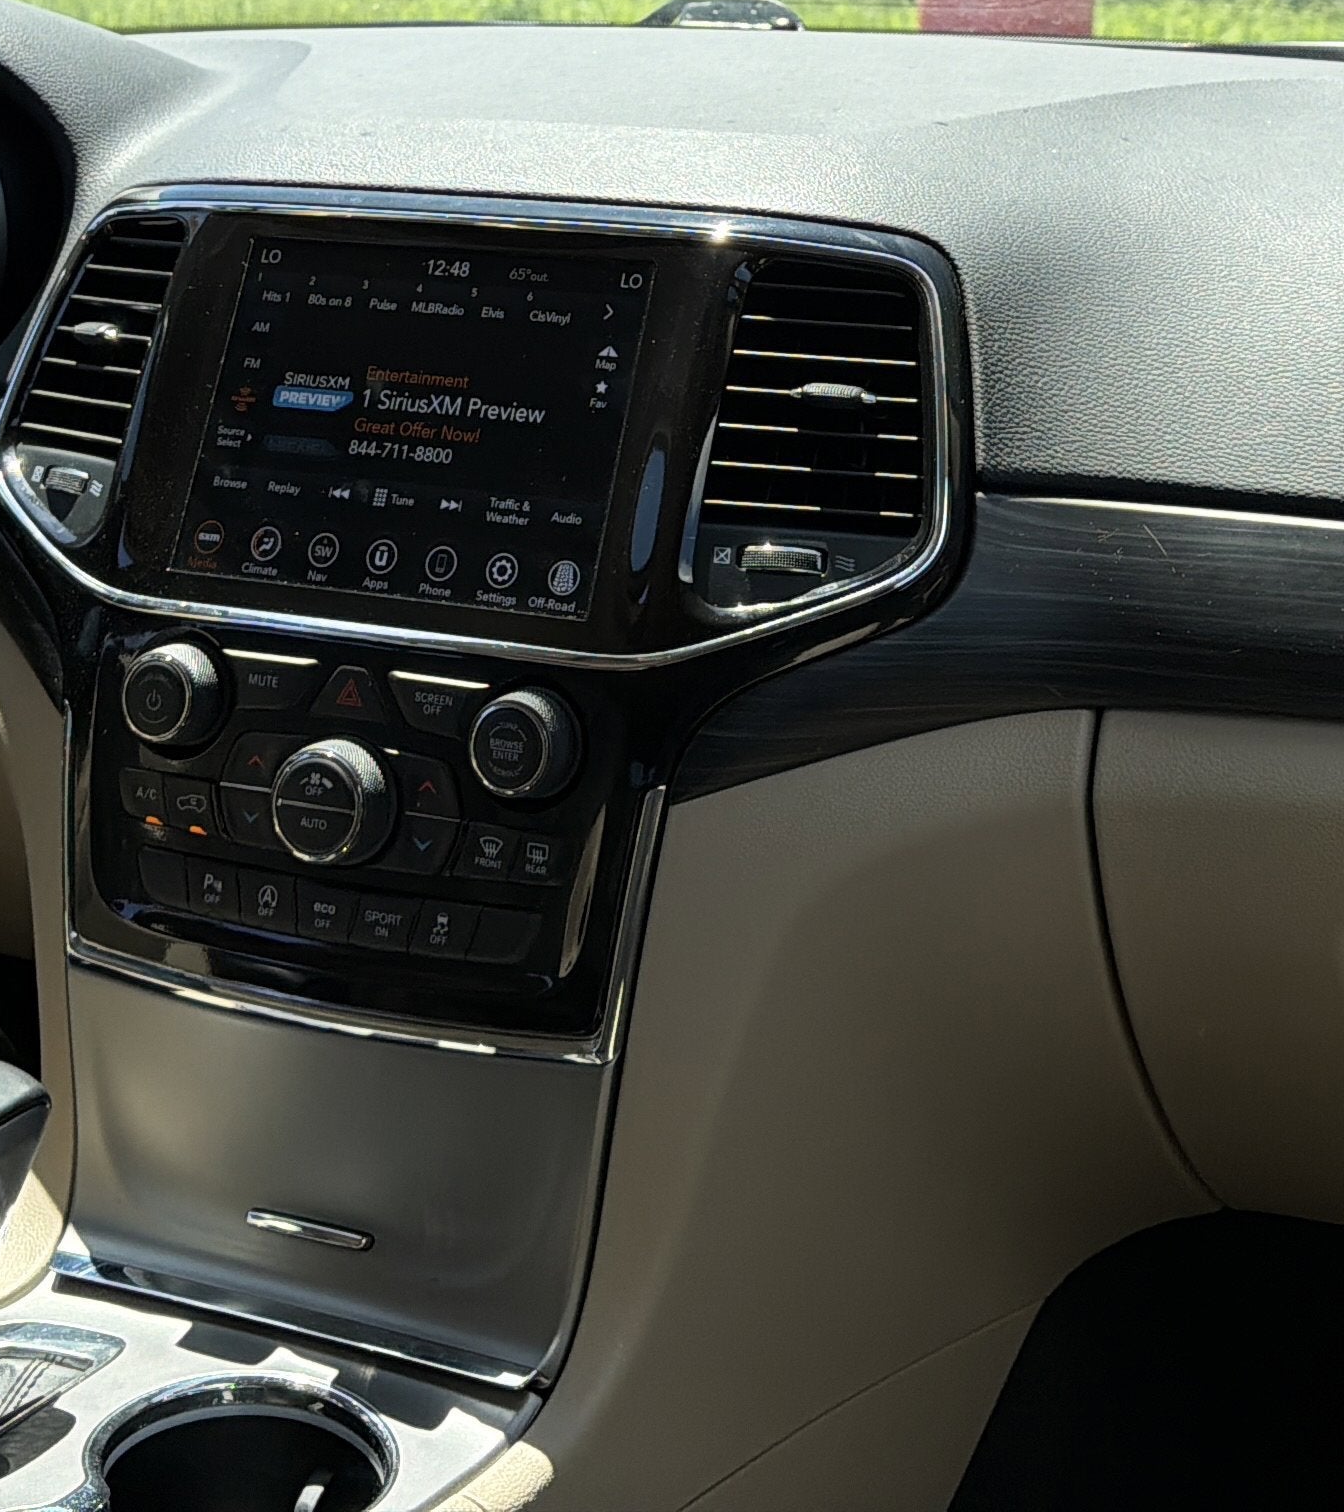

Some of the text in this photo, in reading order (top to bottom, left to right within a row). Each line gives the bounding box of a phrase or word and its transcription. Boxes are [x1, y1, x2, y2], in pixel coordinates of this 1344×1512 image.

[261, 249, 282, 264] LO
[426, 259, 471, 277] 12:48
[309, 276, 316, 286] 2
[362, 280, 368, 289] 3
[621, 273, 642, 289] LO
[416, 284, 422, 293] 4
[471, 288, 478, 297] 5
[262, 290, 290, 302] Hits 1
[308, 294, 352, 307] 80s on 8
[527, 292, 534, 301] 6
[369, 298, 397, 311] Pulse
[411, 301, 464, 316] MLBRadio
[481, 307, 505, 319] Elvis
[252, 322, 270, 333] AM
[244, 358, 260, 369] FM
[595, 359, 617, 371] Map
[283, 372, 350, 389] SIRIUSXM
[366, 366, 469, 388] Entertainment
[280, 390, 346, 408] PREVIEW
[589, 398, 608, 408] Fav
[362, 388, 545, 425] 1 SiriusXM Preview
[217, 426, 245, 437] Source
[354, 418, 481, 443] Great Offer Now!
[216, 437, 241, 448] Select
[348, 439, 453, 465] 844-711-8800
[213, 476, 248, 489] Browse
[268, 481, 301, 496] Replay
[391, 494, 415, 507] Tune
[490, 497, 531, 512] Traffic &
[486, 511, 530, 526] Weather
[550, 511, 582, 525] Audio
[314, 546, 333, 558] SW
[242, 562, 278, 576] Climate
[307, 570, 328, 582] Nav
[362, 577, 389, 589] Apps
[419, 583, 451, 597] Phone
[476, 590, 517, 606] Settings
[248, 673, 279, 688] MUTE
[414, 691, 453, 707] SCREEN
[423, 704, 443, 716] OFF
[490, 737, 524, 751] BROWSE
[493, 751, 519, 762] ENTER
[136, 787, 157, 800] A/C
[306, 786, 322, 796] OFF
[300, 817, 328, 830] AUTO
[474, 856, 504, 869] FRONT
[525, 863, 547, 875] REAR
[204, 894, 220, 904] OFF
[257, 907, 274, 917] OFF
[313, 902, 336, 915] eco
[314, 918, 331, 929] OFF
[364, 910, 402, 926] SPORT
[374, 926, 389, 937] ON
[429, 934, 447, 946] OFF
